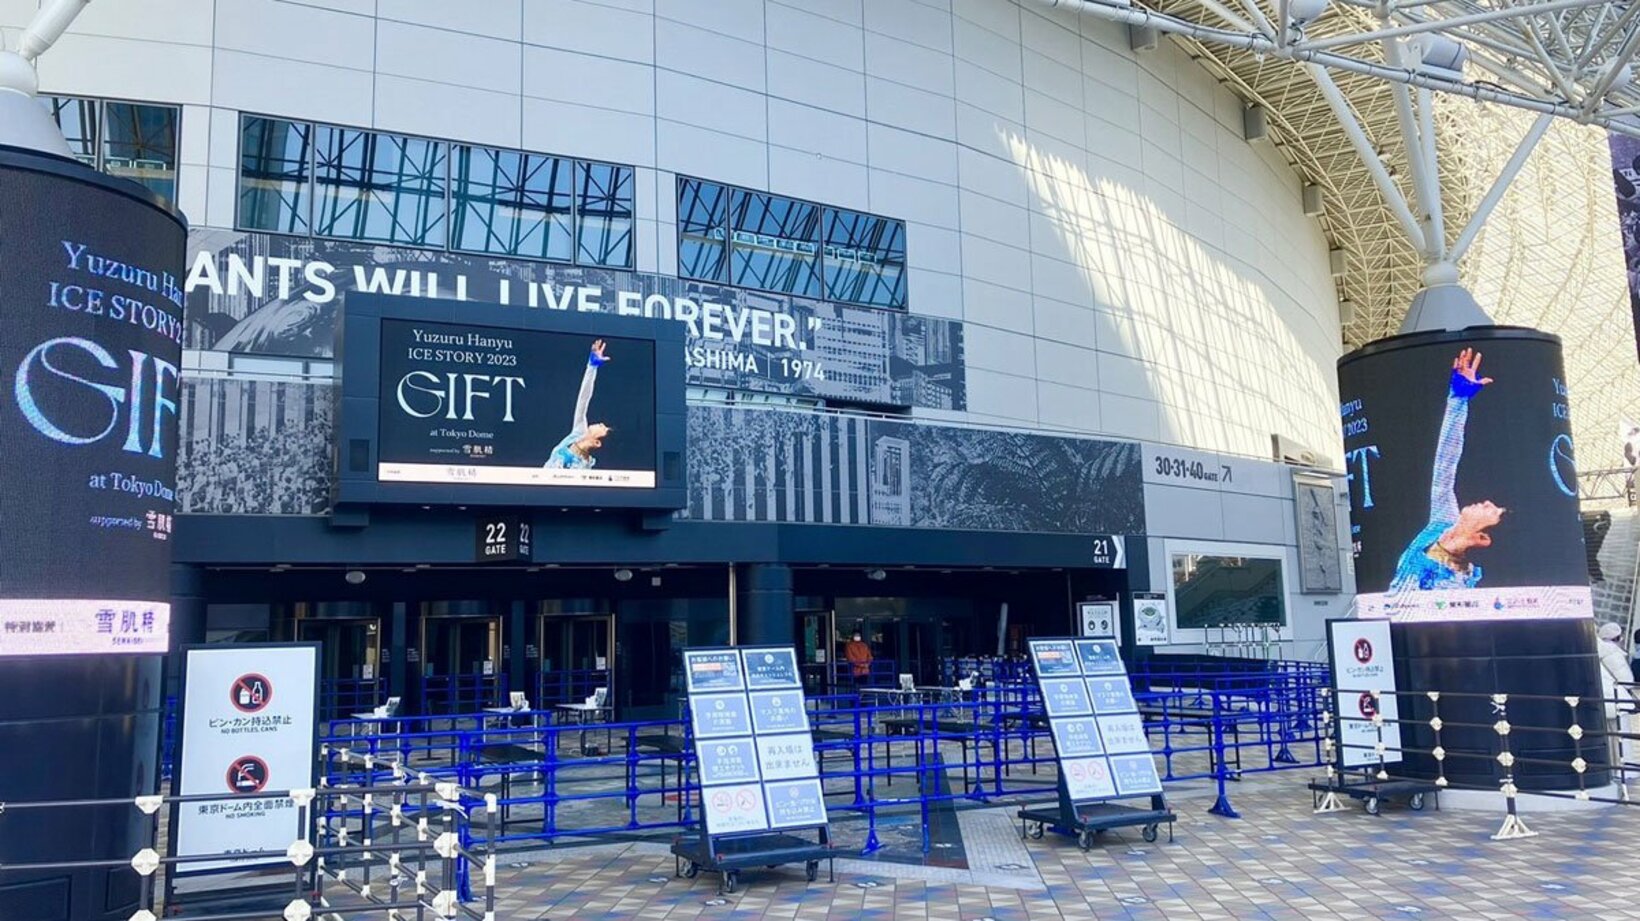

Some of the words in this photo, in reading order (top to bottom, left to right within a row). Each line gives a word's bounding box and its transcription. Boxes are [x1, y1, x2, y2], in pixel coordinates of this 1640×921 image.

[62, 240, 157, 291] Yuzuru
[184, 250, 335, 303] ANTS
[47, 282, 103, 315] ICE
[413, 329, 464, 347] Yuzuru
[467, 333, 513, 349] Hanyu
[408, 348, 433, 361] ICE
[436, 349, 484, 365] STORY
[487, 353, 517, 366] 2023
[781, 358, 825, 381] 1974
[396, 370, 526, 422] GIFT
[430, 428, 438, 437] at
[440, 428, 467, 441] Tokyo
[468, 430, 494, 439] Dome
[89, 474, 106, 488] at
[110, 472, 153, 498] Tokyo
[1204, 472, 1218, 482] GATE
[486, 522, 506, 543] 22
[520, 523, 529, 543] 22
[485, 544, 506, 555] GATE
[1094, 540, 1108, 554] 21
[1094, 556, 1110, 564] GATE
